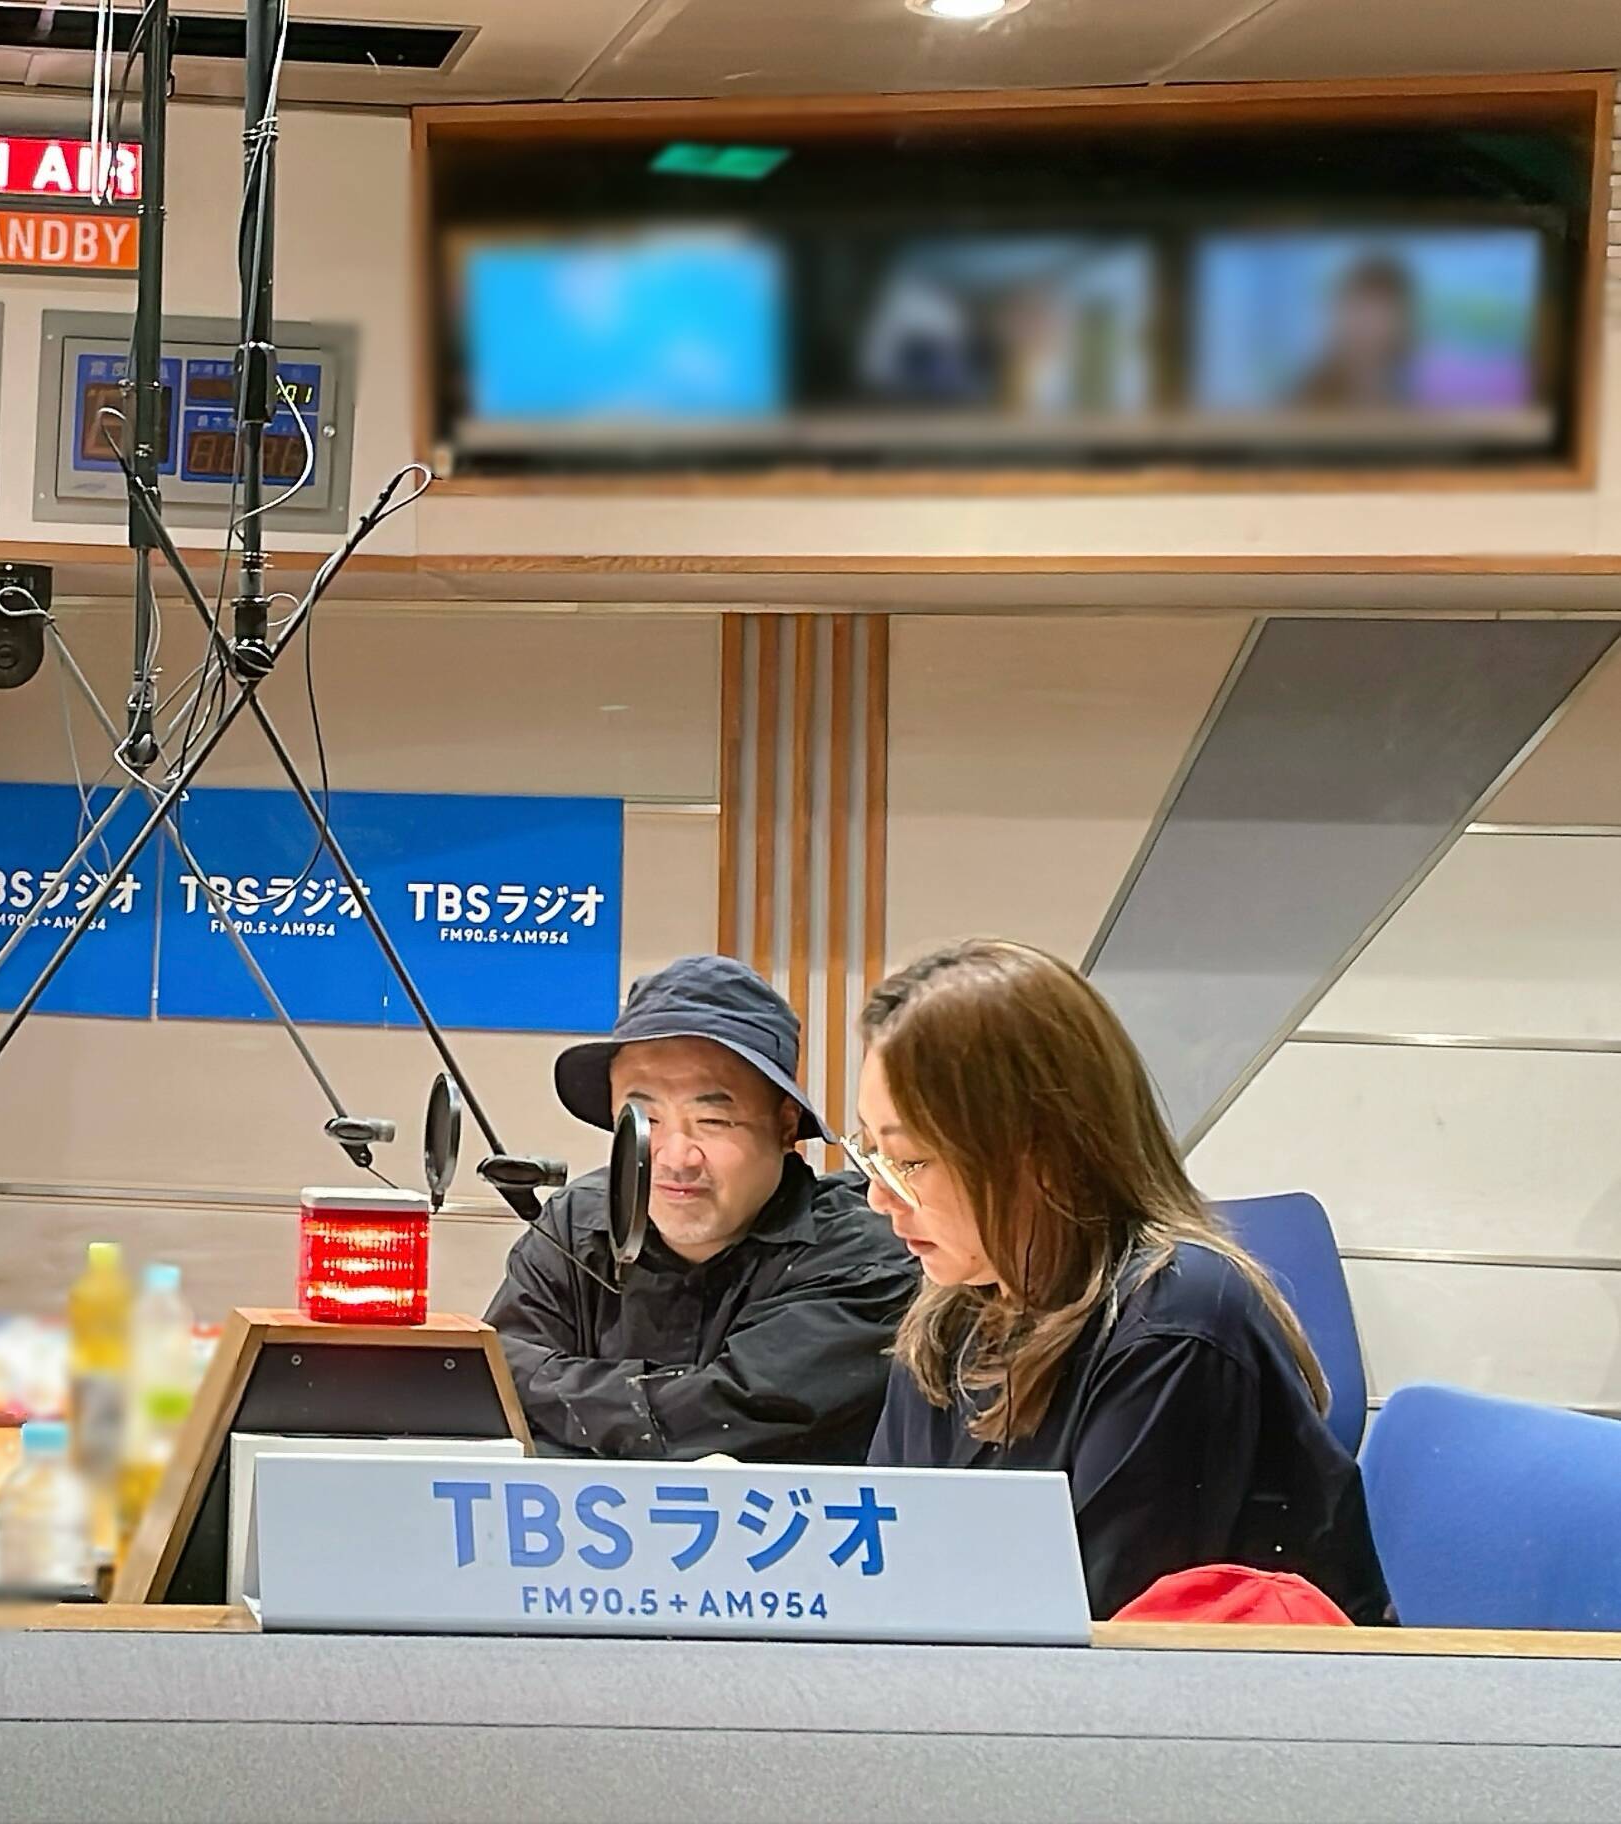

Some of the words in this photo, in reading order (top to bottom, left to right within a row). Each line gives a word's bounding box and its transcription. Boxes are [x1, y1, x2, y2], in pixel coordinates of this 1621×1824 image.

[32, 143, 137, 194] AIR
[179, 875, 372, 920] TBSラジオ
[407, 883, 605, 928] TBSラジオ
[440, 927, 569, 946] FM90.5+AM954
[432, 1481, 897, 1576] TBSラジオ
[522, 1586, 829, 1620] FM90.5+AM954
